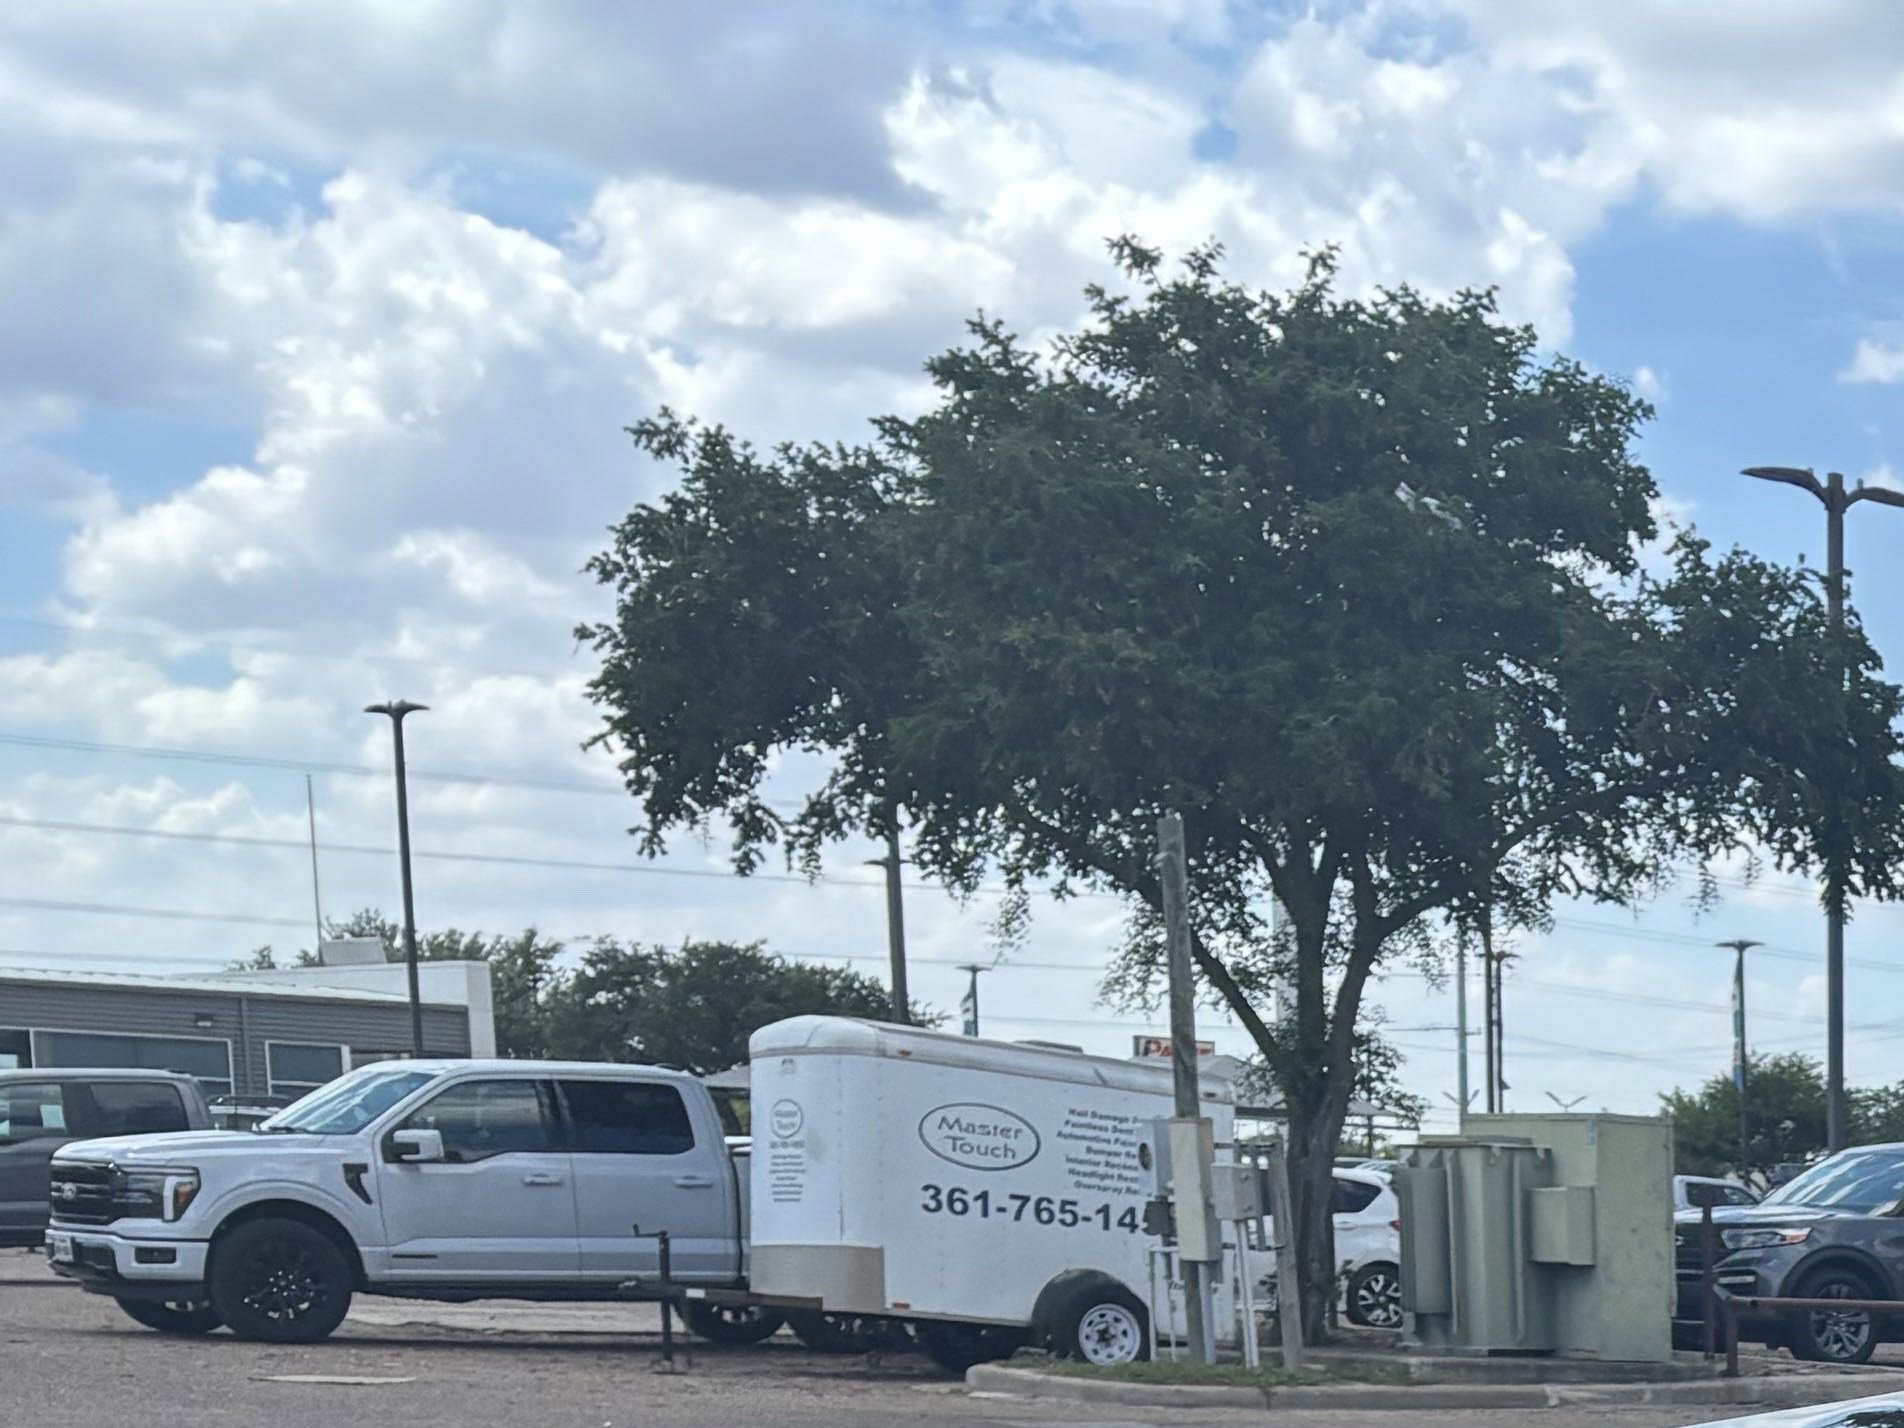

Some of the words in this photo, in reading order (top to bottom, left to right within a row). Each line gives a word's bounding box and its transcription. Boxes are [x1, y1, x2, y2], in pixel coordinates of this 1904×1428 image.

[937, 1115, 1023, 1140] Master
[943, 1135, 1017, 1160] Touch
[921, 1184, 1149, 1236] 361-765-14
